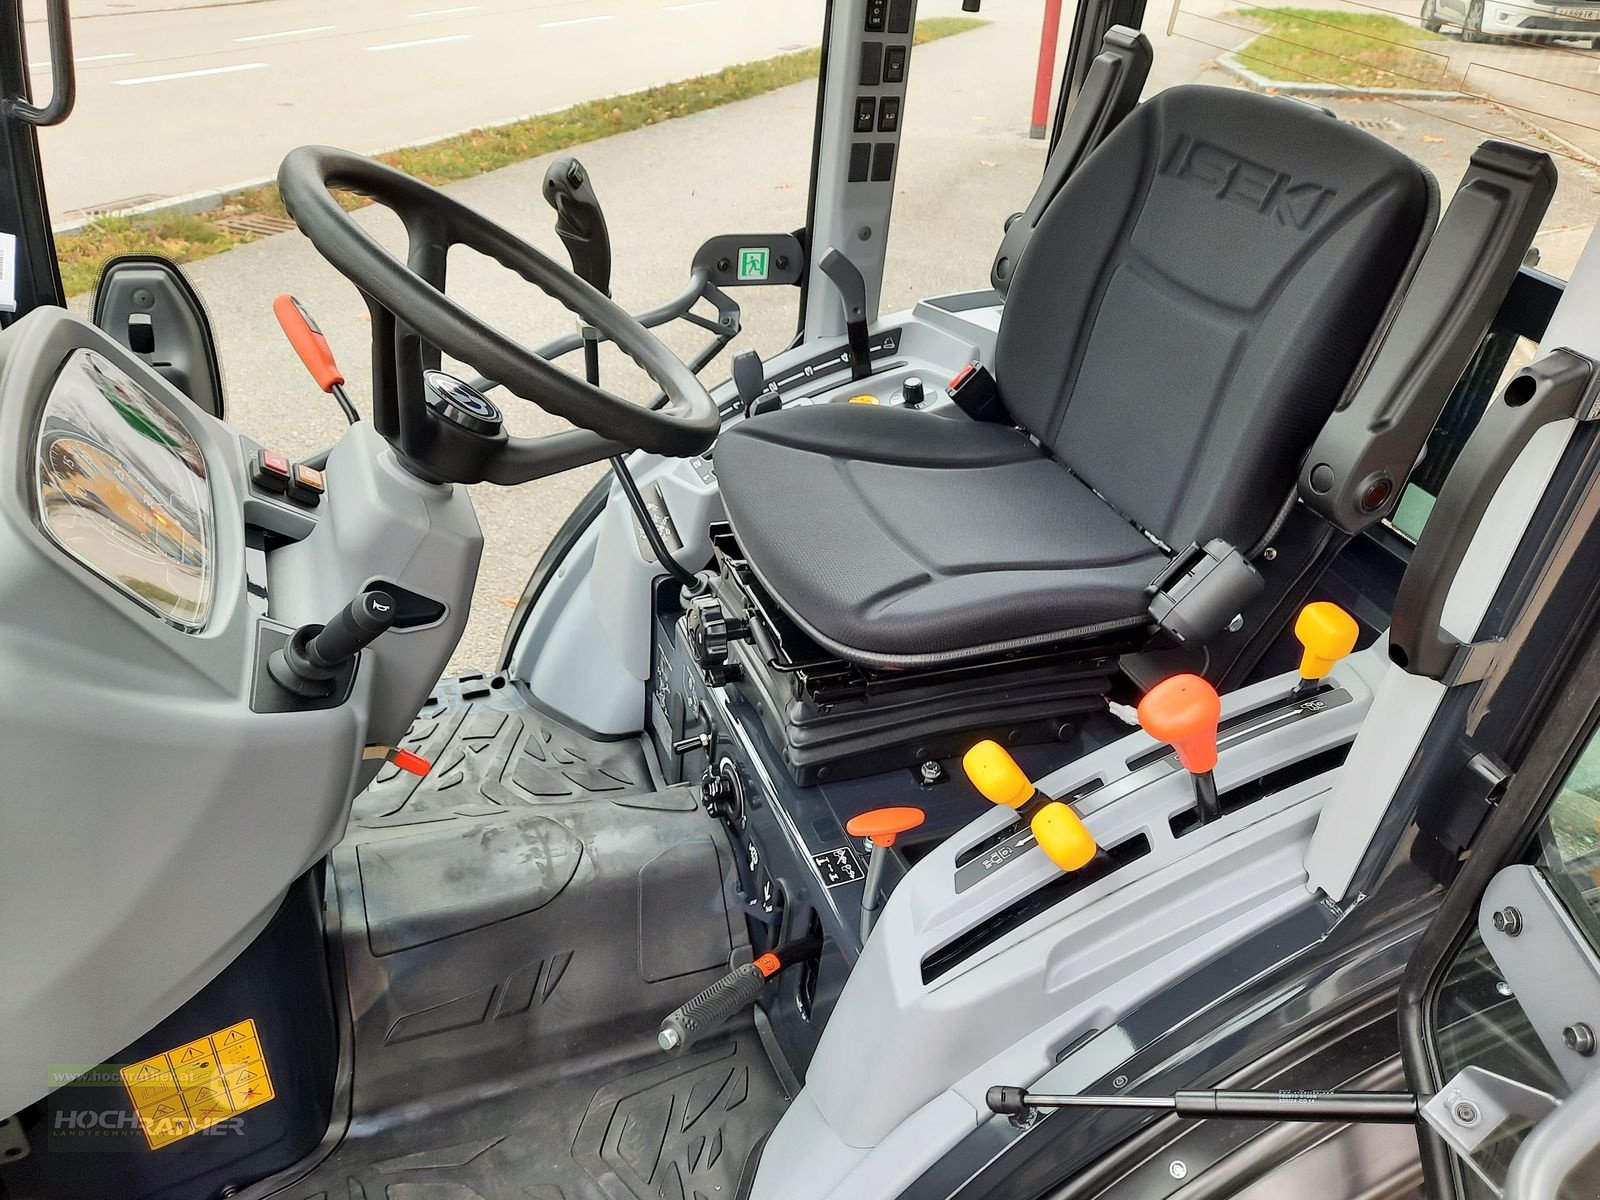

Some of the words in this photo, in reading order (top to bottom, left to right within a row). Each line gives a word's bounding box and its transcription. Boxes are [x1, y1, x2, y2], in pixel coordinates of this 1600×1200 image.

[1157, 133, 1338, 233] ISEKI
[804, 365, 814, 377] 3
[768, 381, 779, 393] 2
